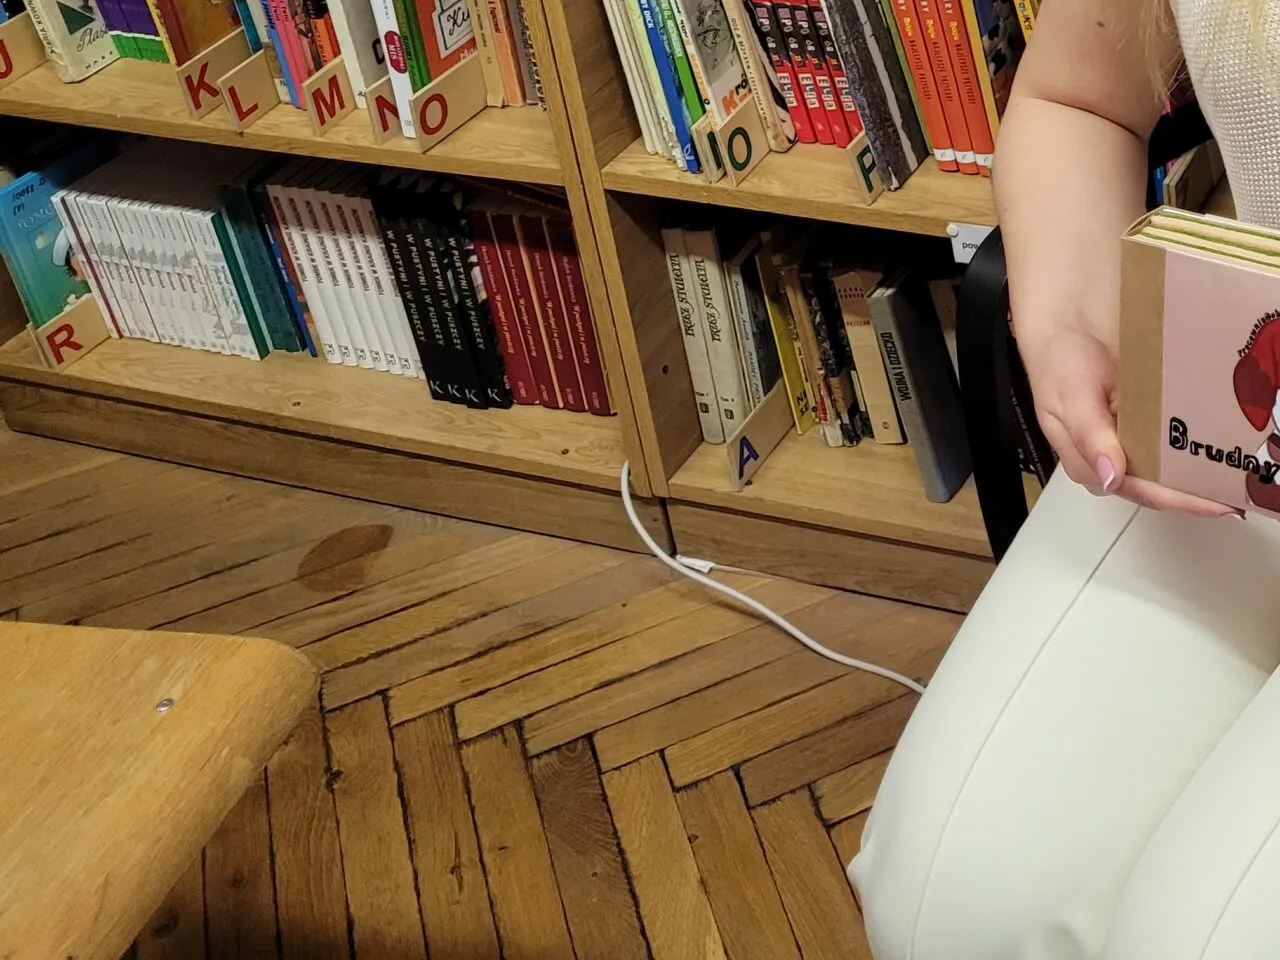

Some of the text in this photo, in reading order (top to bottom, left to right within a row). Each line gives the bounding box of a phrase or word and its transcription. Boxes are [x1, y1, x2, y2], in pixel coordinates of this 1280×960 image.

[643, 8, 655, 30] DICK
[184, 61, 220, 111] K
[227, 63, 259, 121] L
[312, 74, 347, 128] M
[418, 92, 449, 137] O
[727, 127, 751, 171] O
[857, 144, 876, 194] P
[390, 242, 427, 342] PUSTYNI PUSZCZY
[410, 245, 446, 347] PUSTYNI PUSZCZY
[427, 250, 464, 351] PUSTYNI PUSZCZY
[46, 323, 84, 365] R
[738, 436, 759, 480] A
